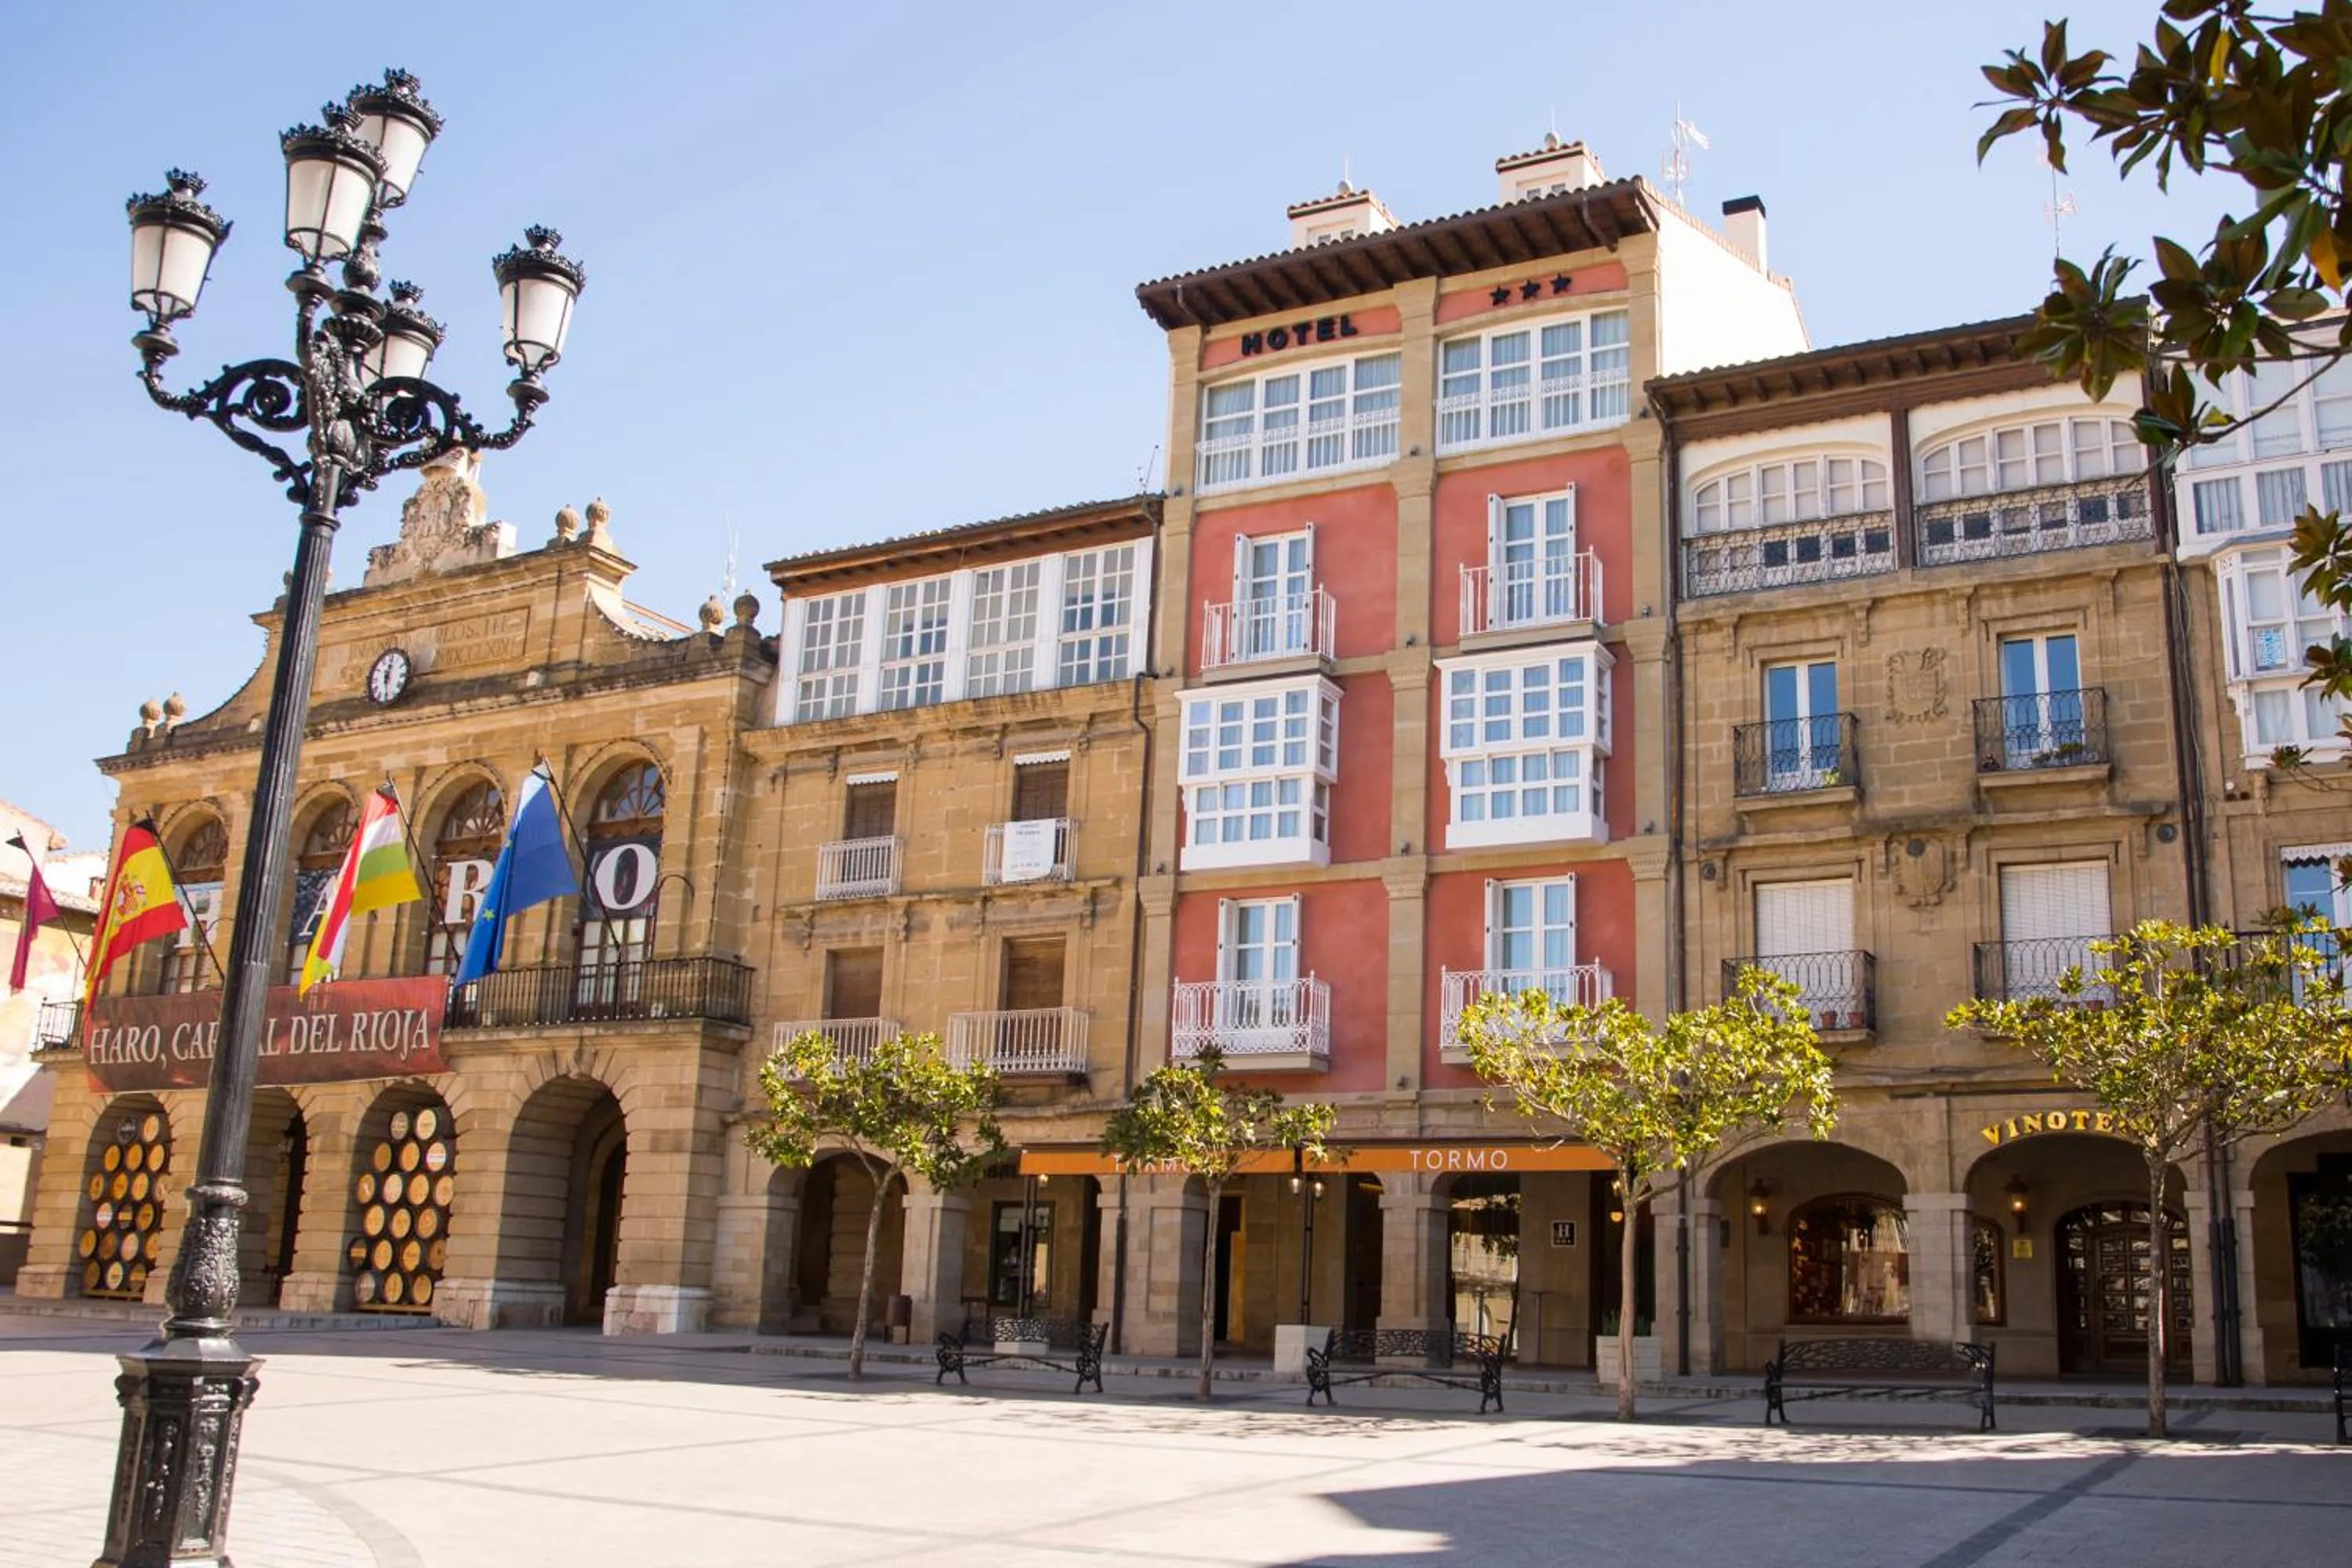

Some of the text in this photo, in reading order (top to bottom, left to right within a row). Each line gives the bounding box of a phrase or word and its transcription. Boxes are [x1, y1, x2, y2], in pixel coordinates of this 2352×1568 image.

[1242, 313, 1359, 357] HOTEL
[90, 1008, 430, 1069] HARO, CAPL DEL RIOJA
[1982, 1109, 2129, 1145] VINOTE
[1409, 1149, 1508, 1171] TORMO
[1558, 1224, 1570, 1238] H
